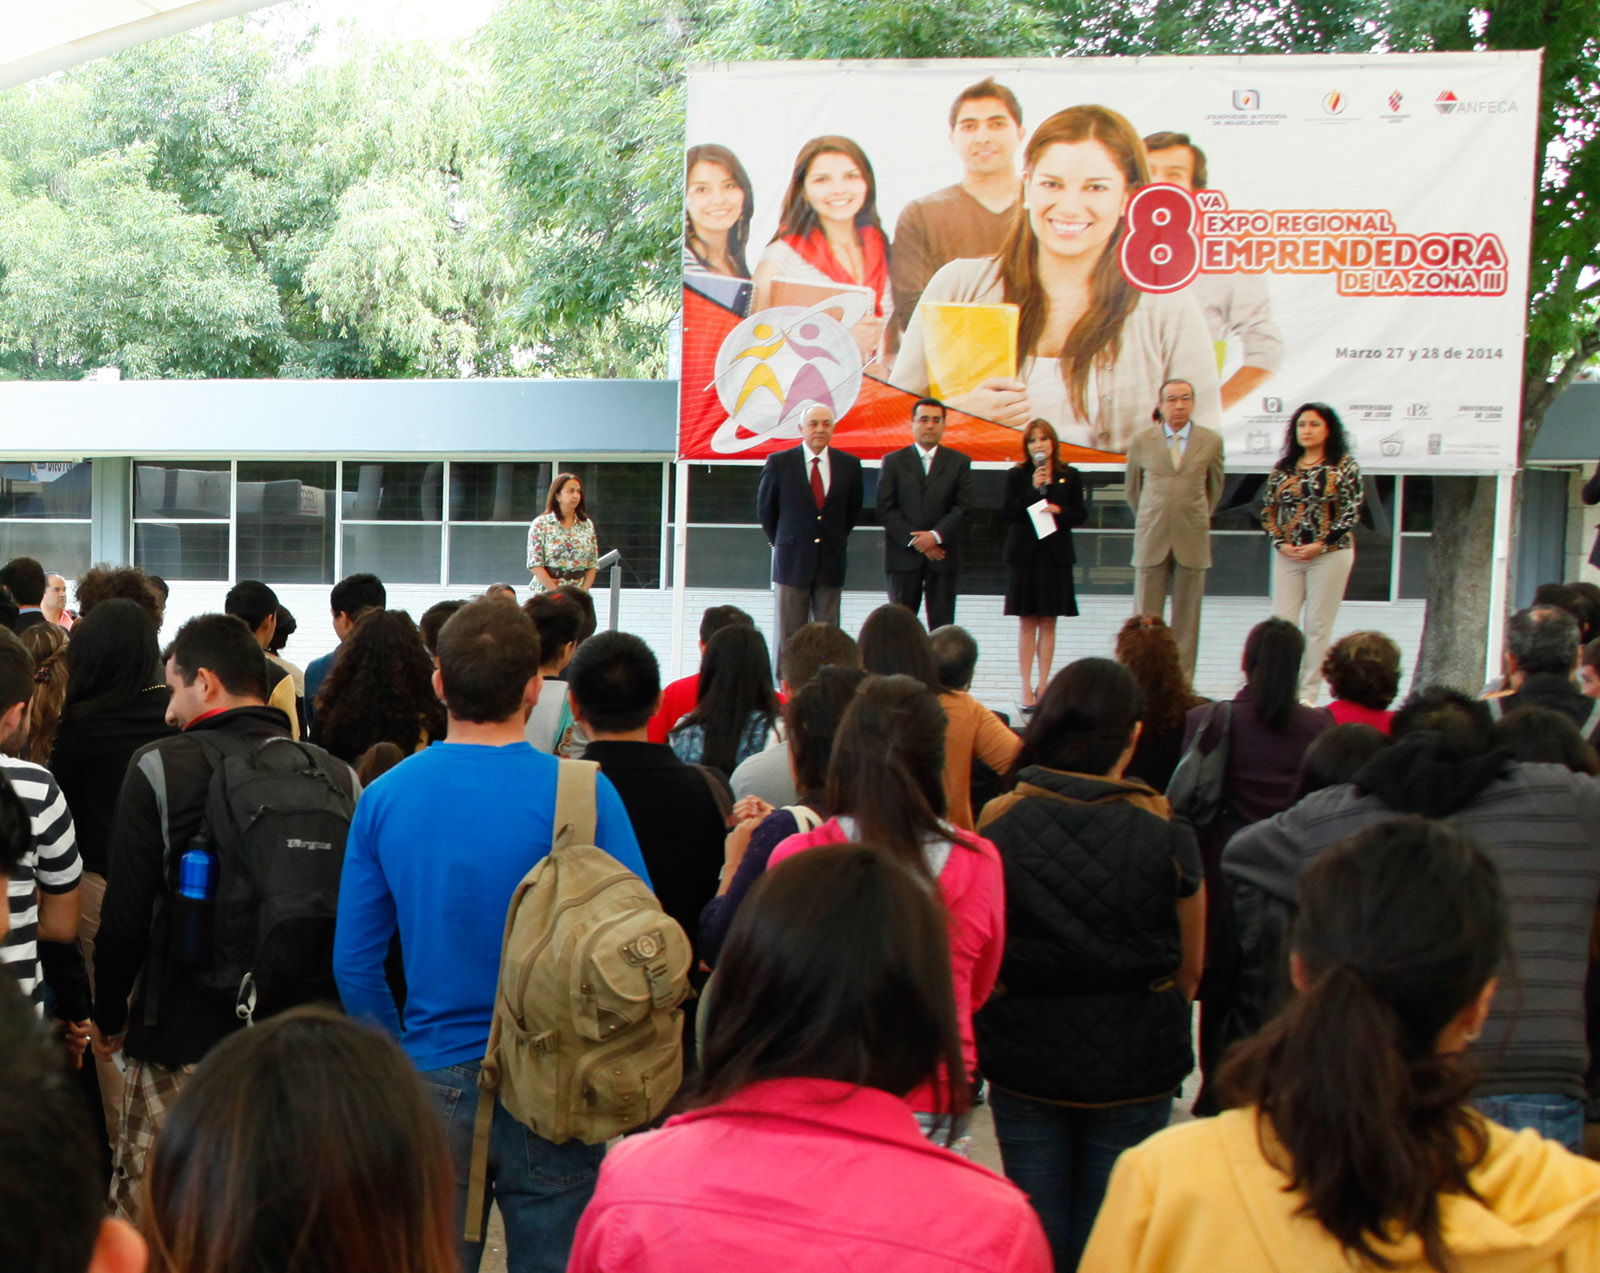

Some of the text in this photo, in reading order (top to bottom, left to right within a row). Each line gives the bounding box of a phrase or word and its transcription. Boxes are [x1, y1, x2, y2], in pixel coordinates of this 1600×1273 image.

[1456, 101, 1518, 114] ANFECA
[1199, 195, 1224, 210] VA
[1206, 214, 1391, 234] EXPO REGIONAL
[1124, 187, 1197, 289] 8
[1204, 237, 1503, 269] EMPRENDEDORA
[1344, 271, 1502, 291] DE LA ZONA III
[1335, 346, 1504, 362] Marzo 27 y 28 de 2014
